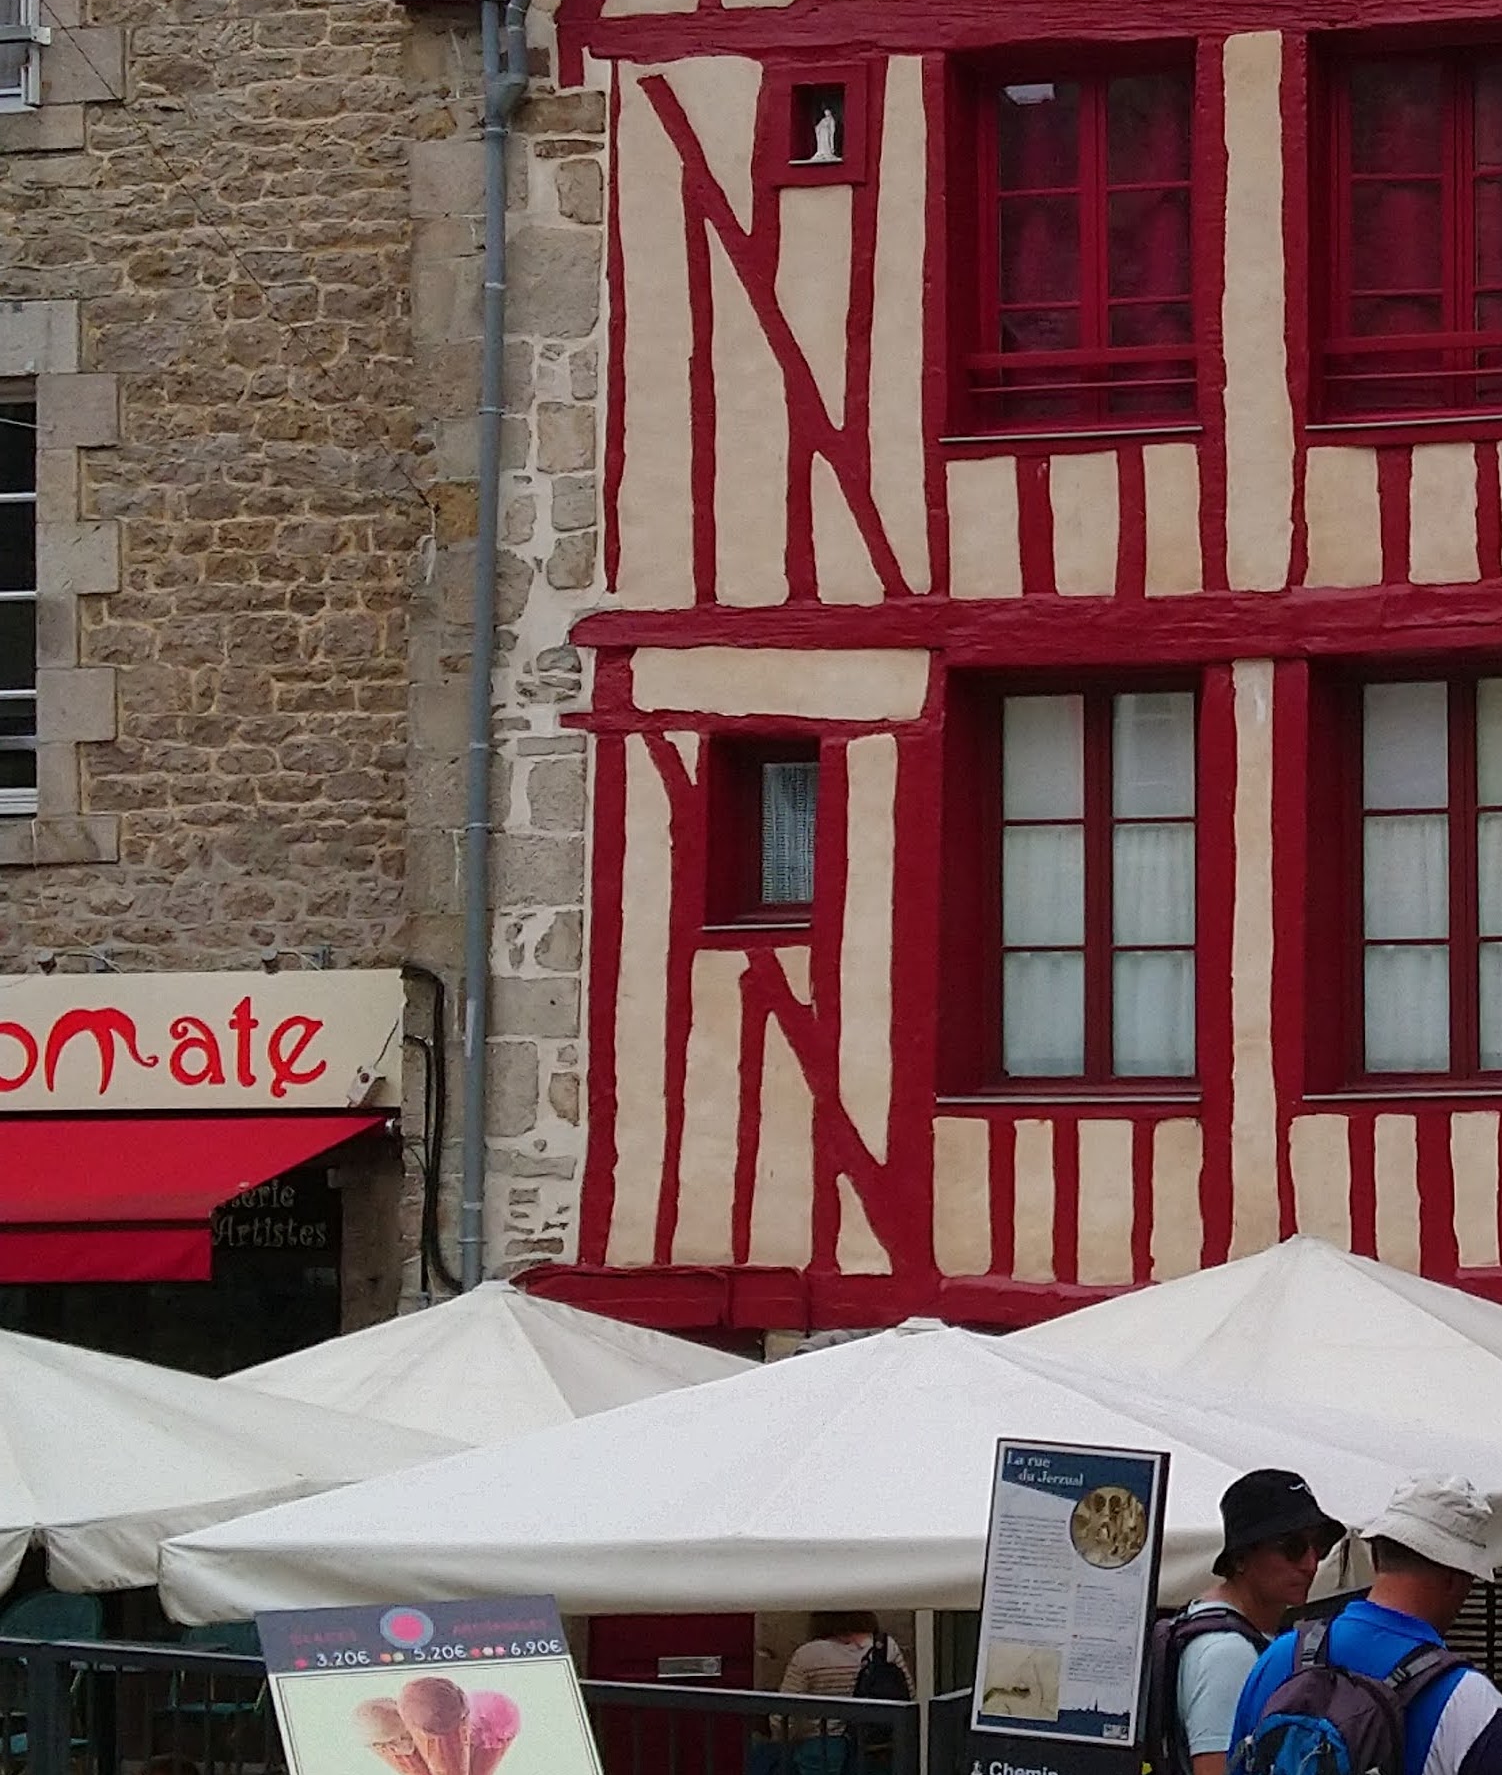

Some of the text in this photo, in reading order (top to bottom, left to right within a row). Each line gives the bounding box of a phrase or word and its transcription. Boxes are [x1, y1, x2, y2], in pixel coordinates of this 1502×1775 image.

[212, 1215, 327, 1247] Artistes
[1007, 1450, 1051, 1468] La rue
[1018, 1468, 1084, 1487] du Jerzual
[316, 1638, 563, 1668] 3.20€ 5.20€ 6.90€
